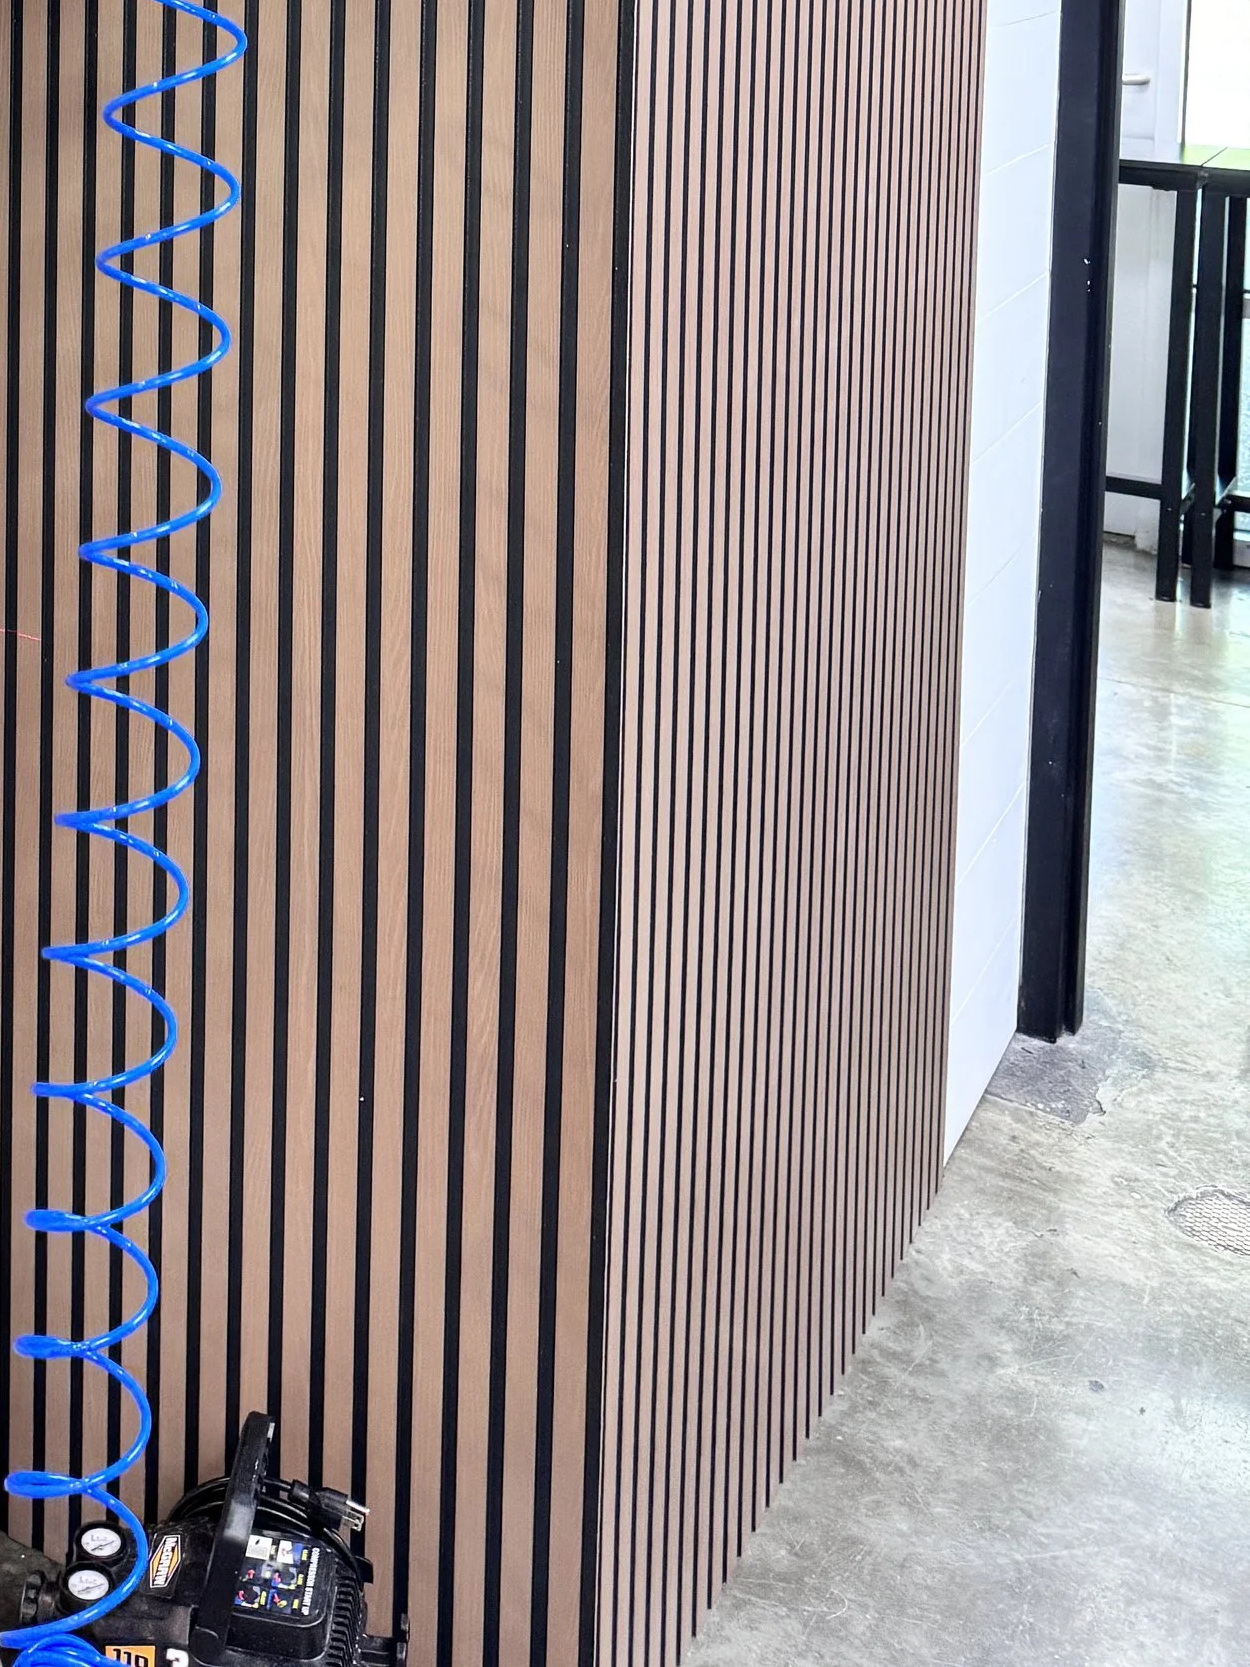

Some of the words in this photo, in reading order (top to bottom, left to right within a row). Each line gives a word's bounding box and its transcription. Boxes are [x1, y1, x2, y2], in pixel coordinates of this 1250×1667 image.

[306, 1547, 320, 1586] COMPRESSOR
[302, 1587, 314, 1606] START
[301, 1606, 310, 1616] UP
